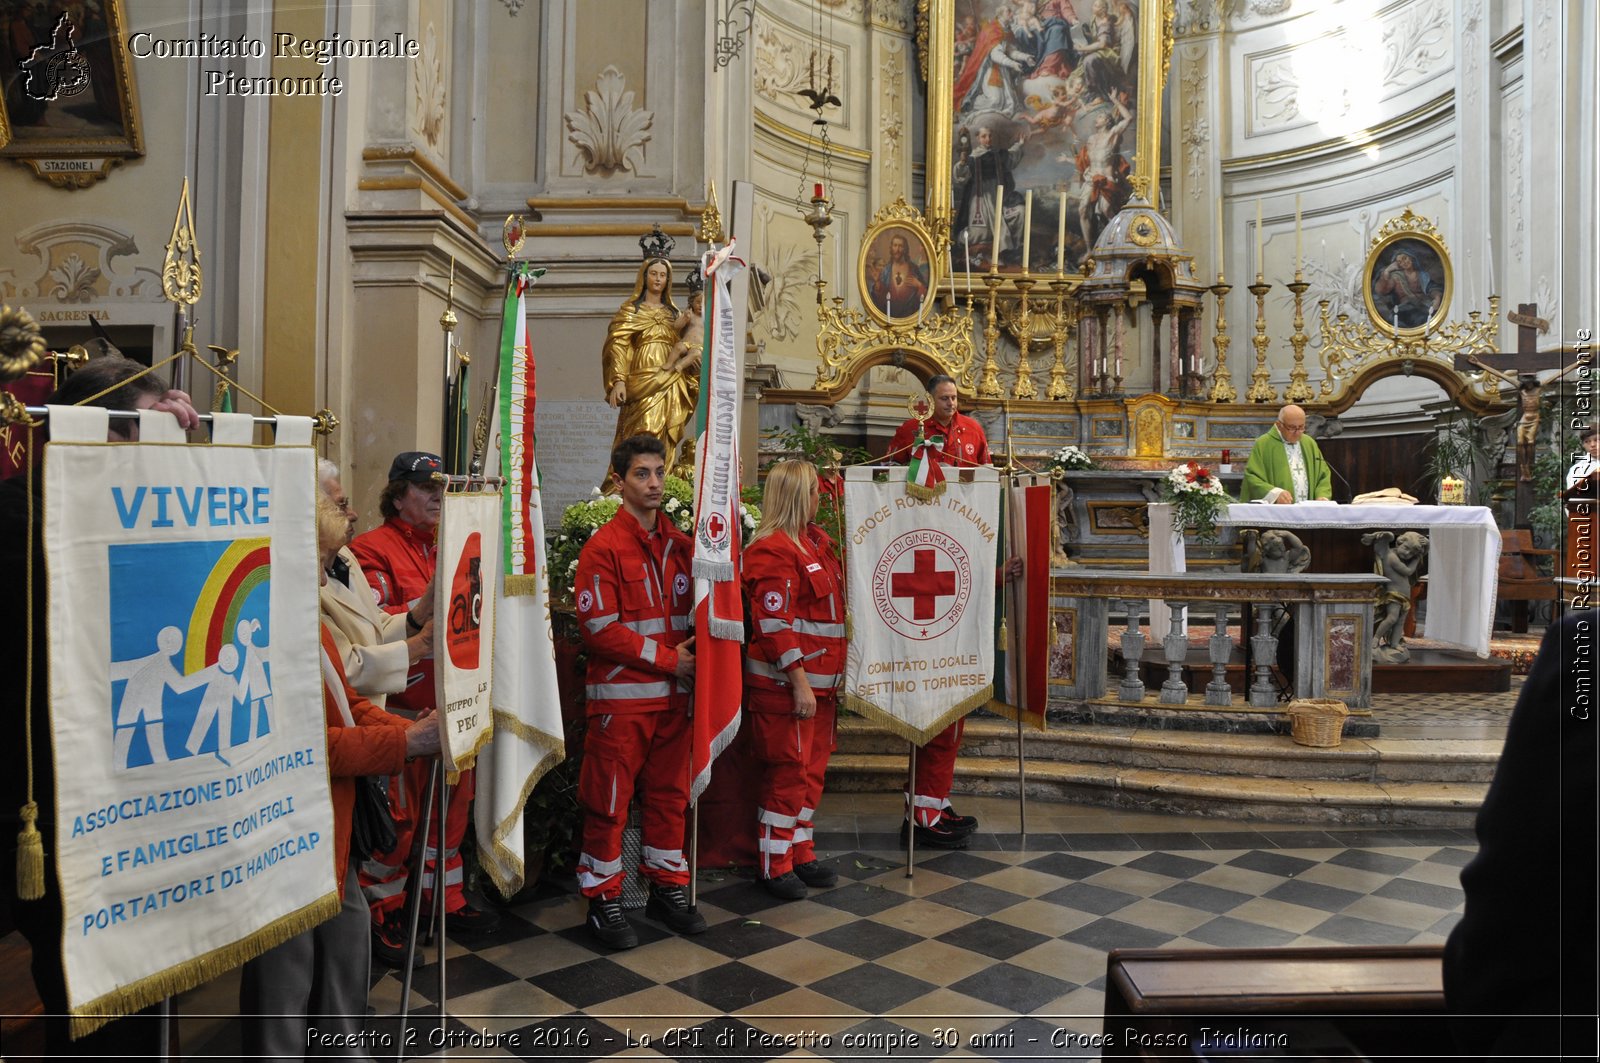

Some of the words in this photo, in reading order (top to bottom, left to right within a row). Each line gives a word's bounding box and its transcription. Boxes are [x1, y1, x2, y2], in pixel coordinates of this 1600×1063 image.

[44, 161, 88, 170] STAZIONE
[40, 310, 110, 321] SACRESTIA
[509, 345, 529, 425] ITALIANA
[508, 431, 526, 495] ROSSA
[111, 486, 270, 529] VIVERE
[853, 505, 892, 545] CROCE
[947, 497, 996, 544] ITALIANA
[509, 499, 527, 567] CROCE
[893, 541, 905, 554] DI
[905, 532, 948, 548] GINEVRA
[947, 542, 961, 557] 22
[874, 550, 900, 626] CONVENZIONE
[956, 554, 969, 602] AGOSTO
[948, 602, 964, 624] 1864
[857, 680, 917, 697] SETTIMO
[921, 673, 986, 691] TORINESE
[867, 659, 928, 676] COMITATO
[932, 654, 978, 670] LOCALE
[446, 697, 473, 713] RUPPO
[71, 781, 221, 838] ASSOCIAZIONE
[225, 774, 243, 797] DI
[245, 748, 315, 788] VOLONTARI
[101, 855, 113, 877] E
[117, 826, 229, 871] FAMIGLIE
[232, 810, 258, 840] CON
[259, 796, 295, 826] FIGLI
[82, 875, 216, 936] PORTATORI
[220, 865, 243, 889] DI
[246, 831, 321, 879] HANDICAP
